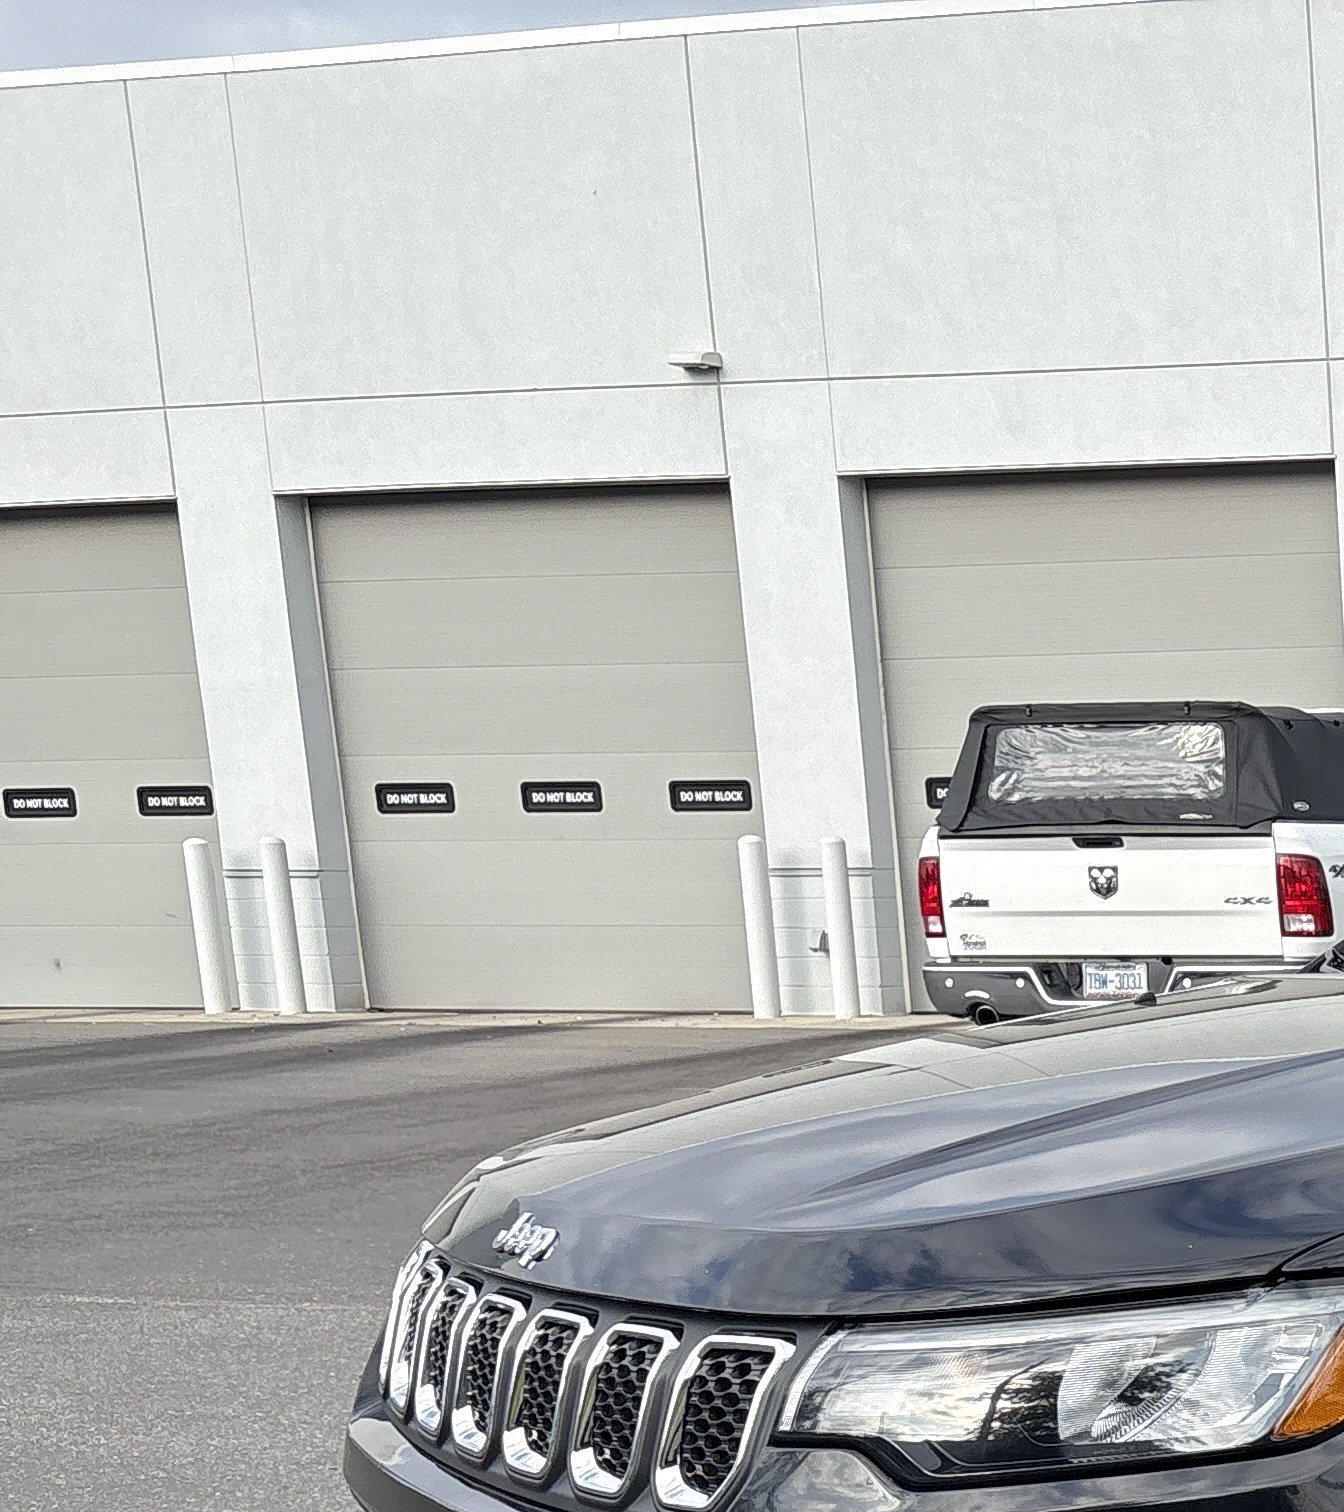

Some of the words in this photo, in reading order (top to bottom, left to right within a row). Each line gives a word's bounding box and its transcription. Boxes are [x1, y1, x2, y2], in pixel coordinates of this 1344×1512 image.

[147, 796, 160, 806] DO
[161, 796, 178, 806] NOT
[178, 795, 206, 806] BLOCK
[386, 793, 399, 804] DO
[400, 793, 418, 804] NOT
[419, 793, 447, 804] BLOCK
[531, 791, 545, 802] DO
[546, 791, 564, 802] NOT
[565, 791, 594, 802] BLOCK
[680, 790, 694, 802] DO
[694, 790, 713, 802] NOT
[714, 790, 743, 802] BLOCK
[13, 798, 25, 808] DO
[26, 798, 42, 808] NOT
[43, 798, 69, 808] BLOCK
[492, 1212, 559, 1268] Jeep
